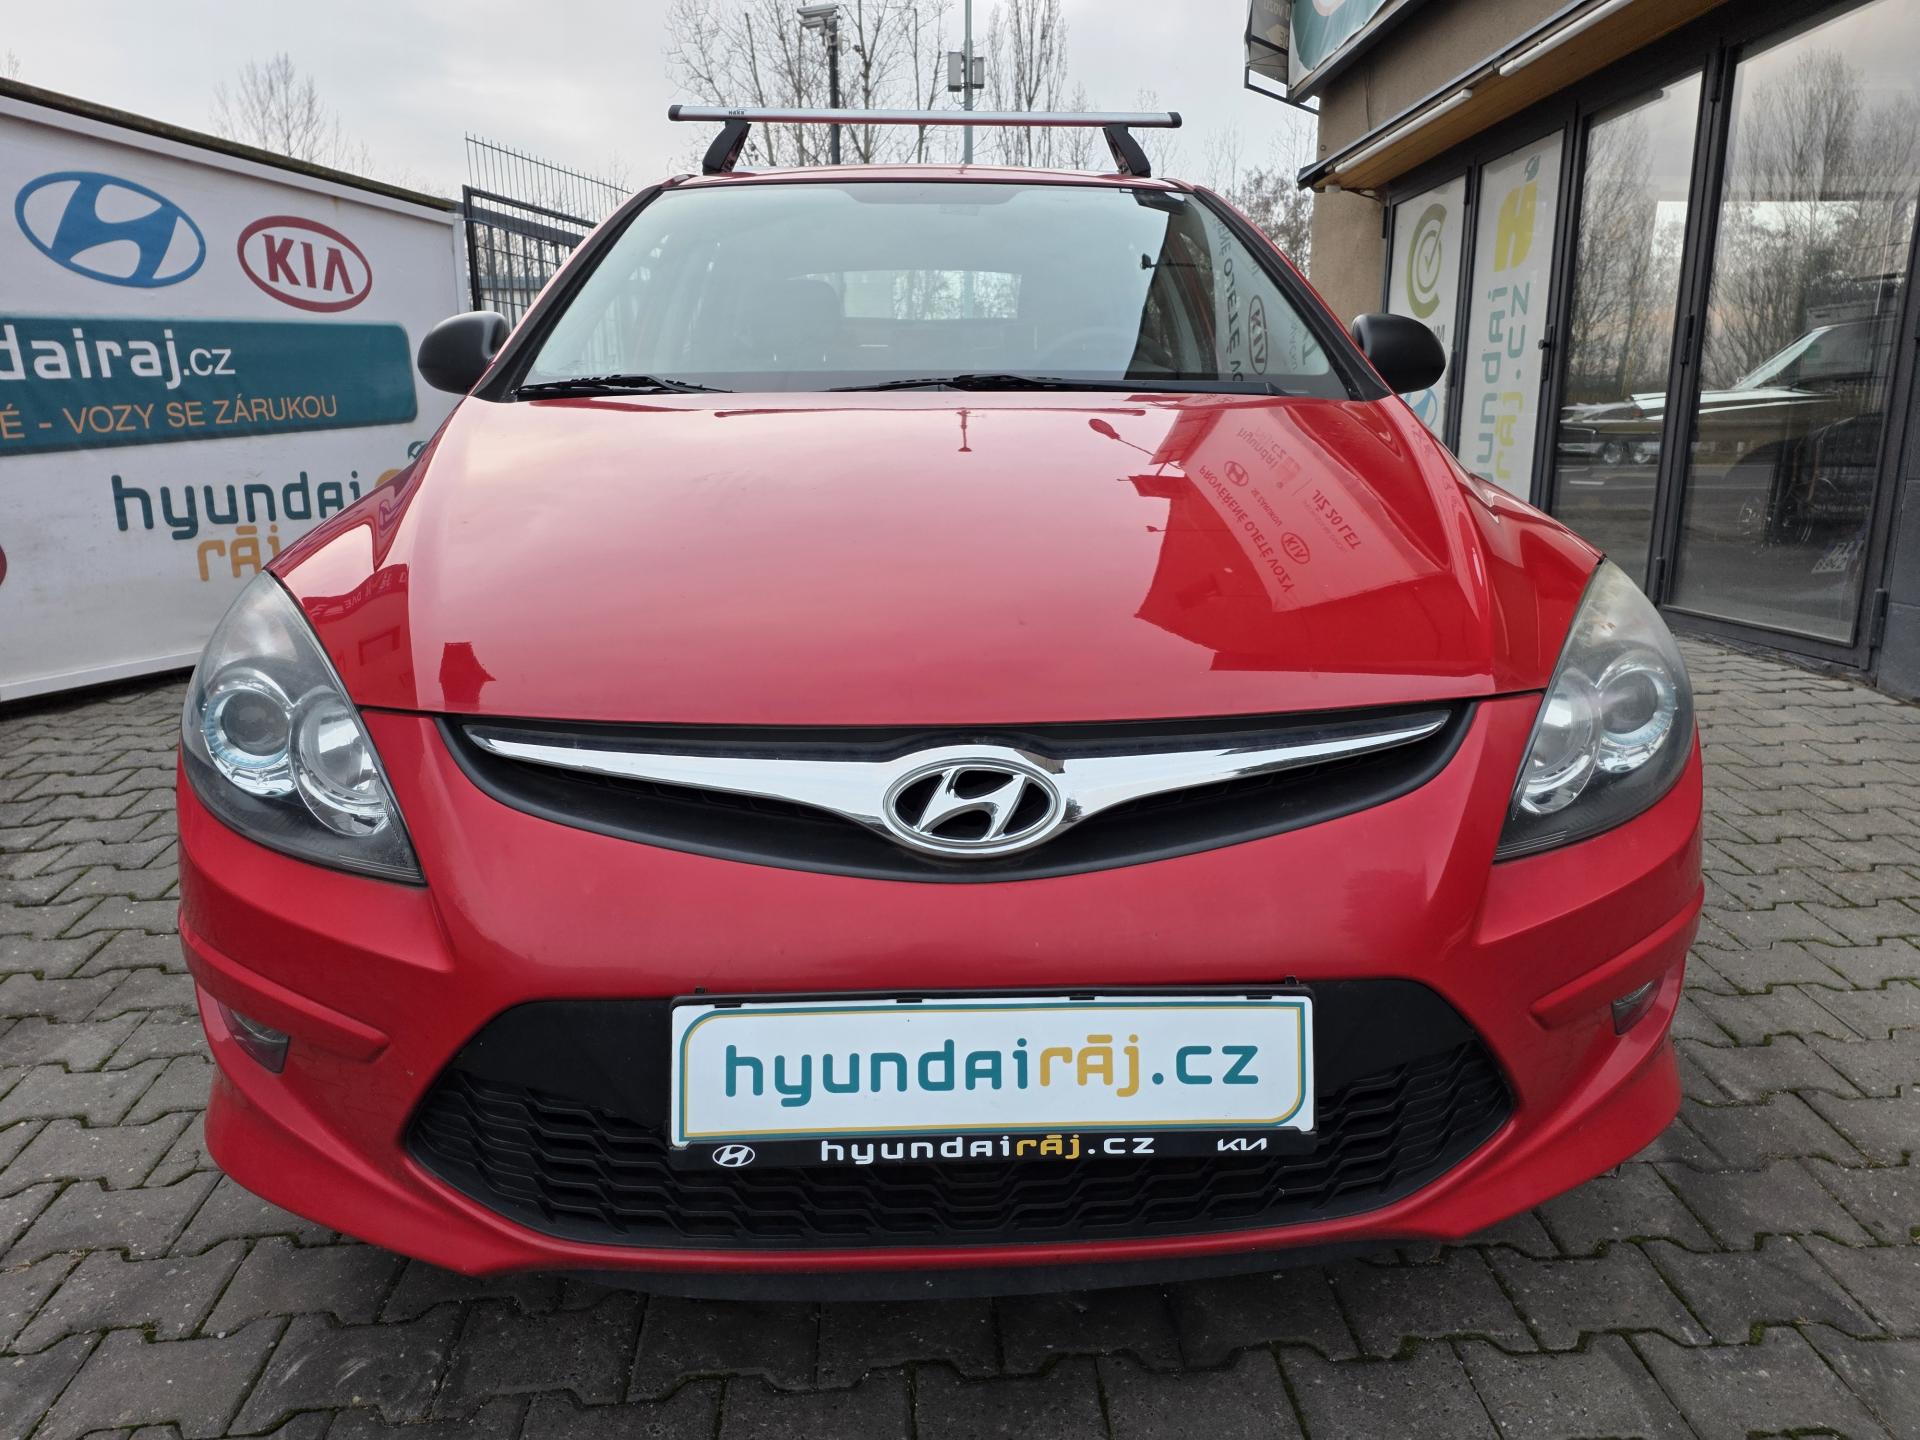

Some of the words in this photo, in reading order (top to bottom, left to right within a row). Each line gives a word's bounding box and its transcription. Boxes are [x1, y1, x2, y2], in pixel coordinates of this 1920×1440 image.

[262, 234, 355, 295] KIA
[62, 403, 154, 434] VOZY
[166, 401, 206, 428] SE
[213, 394, 338, 425] ZÁRUKOU
